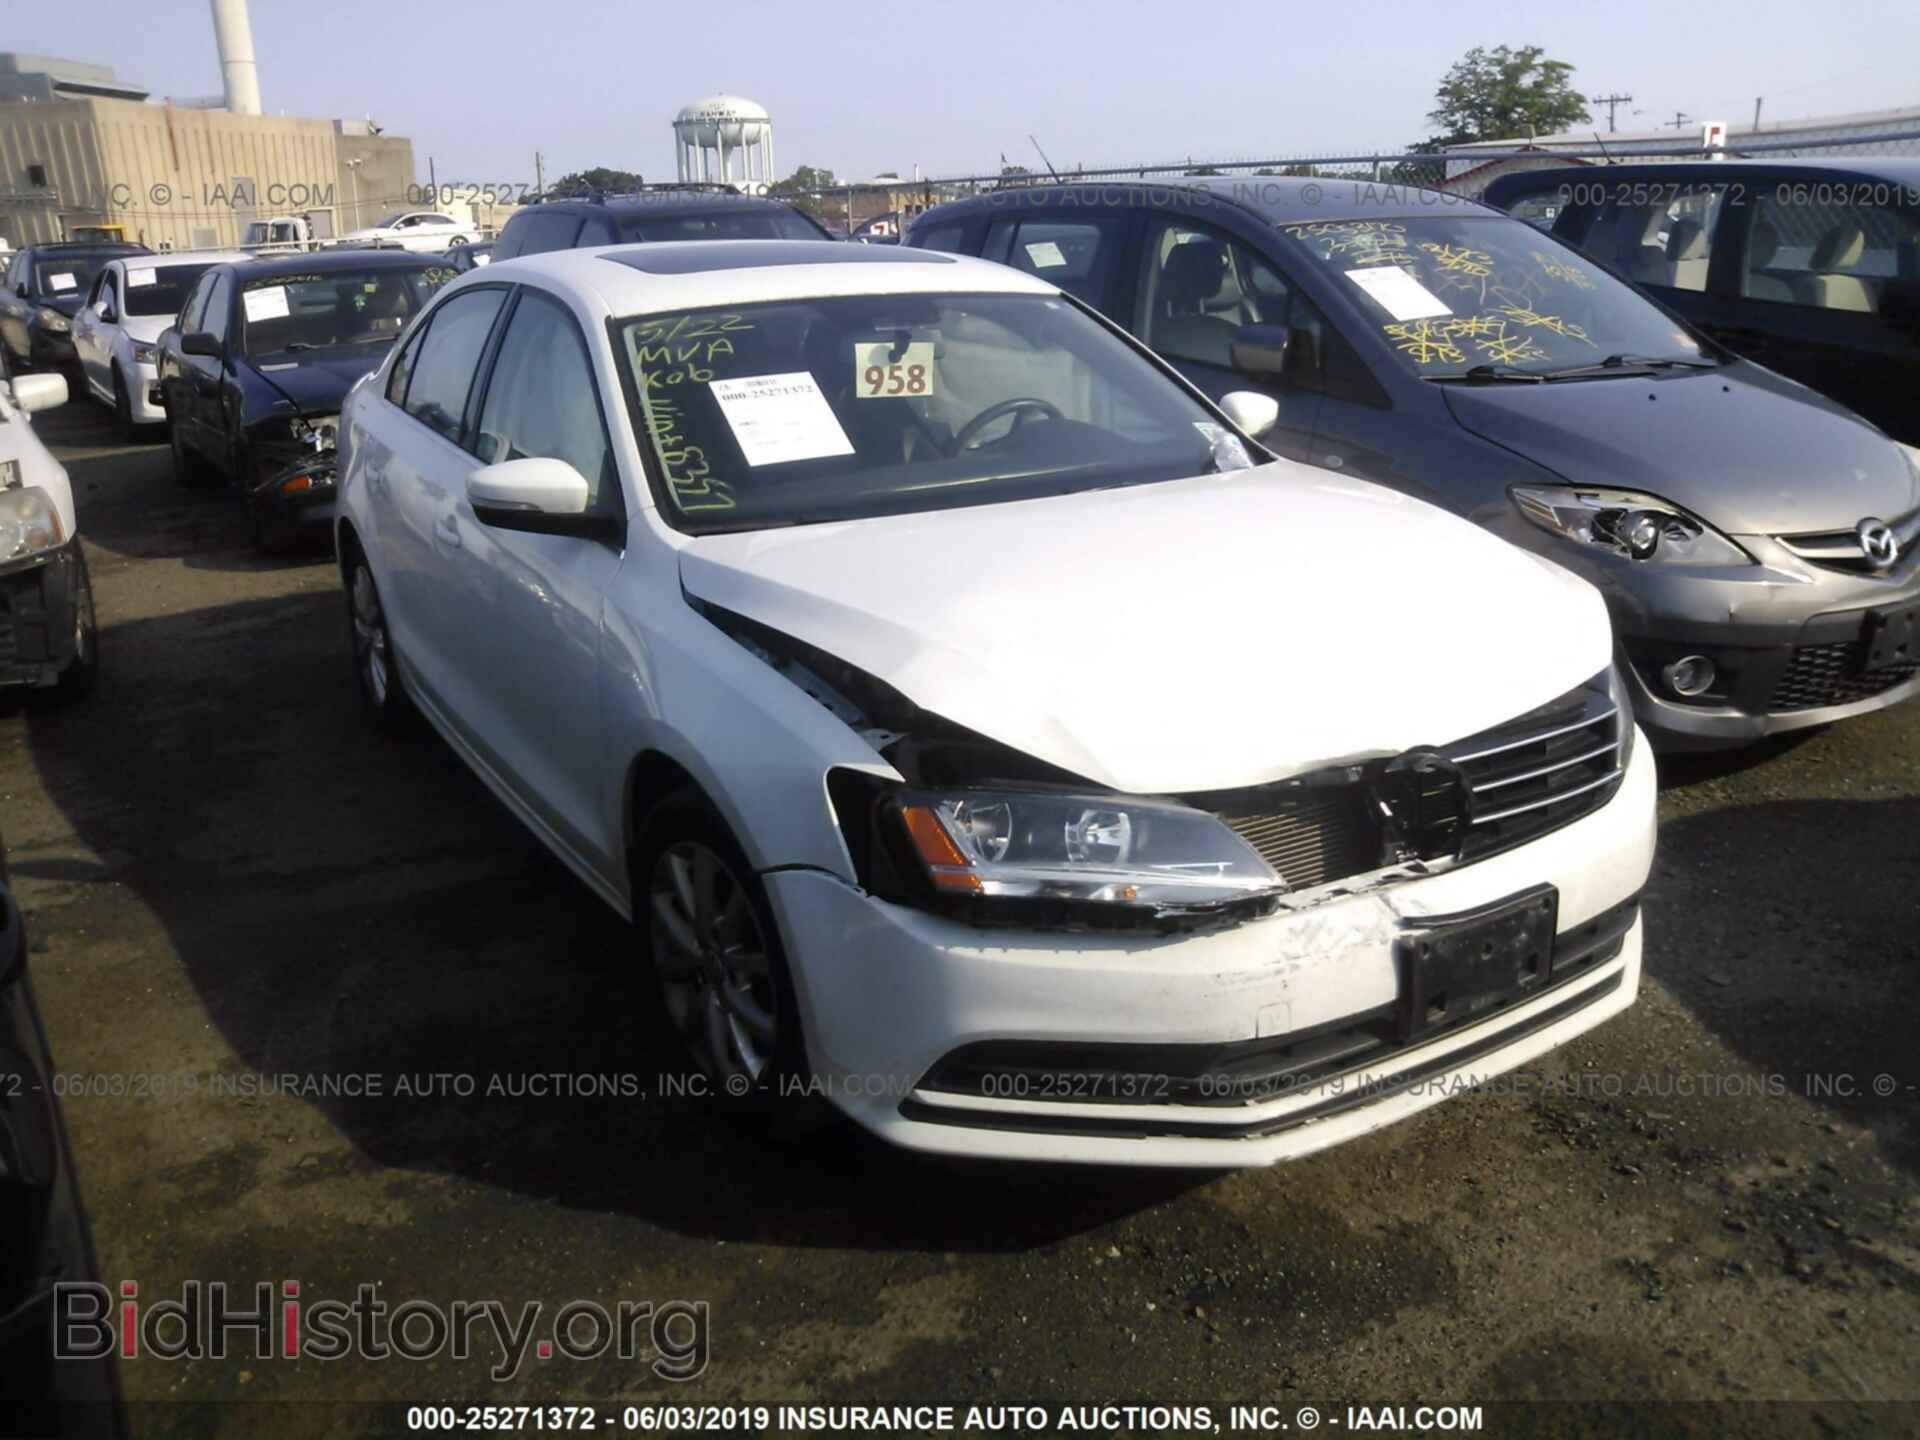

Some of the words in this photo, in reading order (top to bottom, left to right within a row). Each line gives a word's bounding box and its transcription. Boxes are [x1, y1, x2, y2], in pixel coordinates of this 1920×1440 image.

[635, 313, 756, 345] 5/22
[637, 338, 735, 365] MVA
[864, 364, 926, 396] 958
